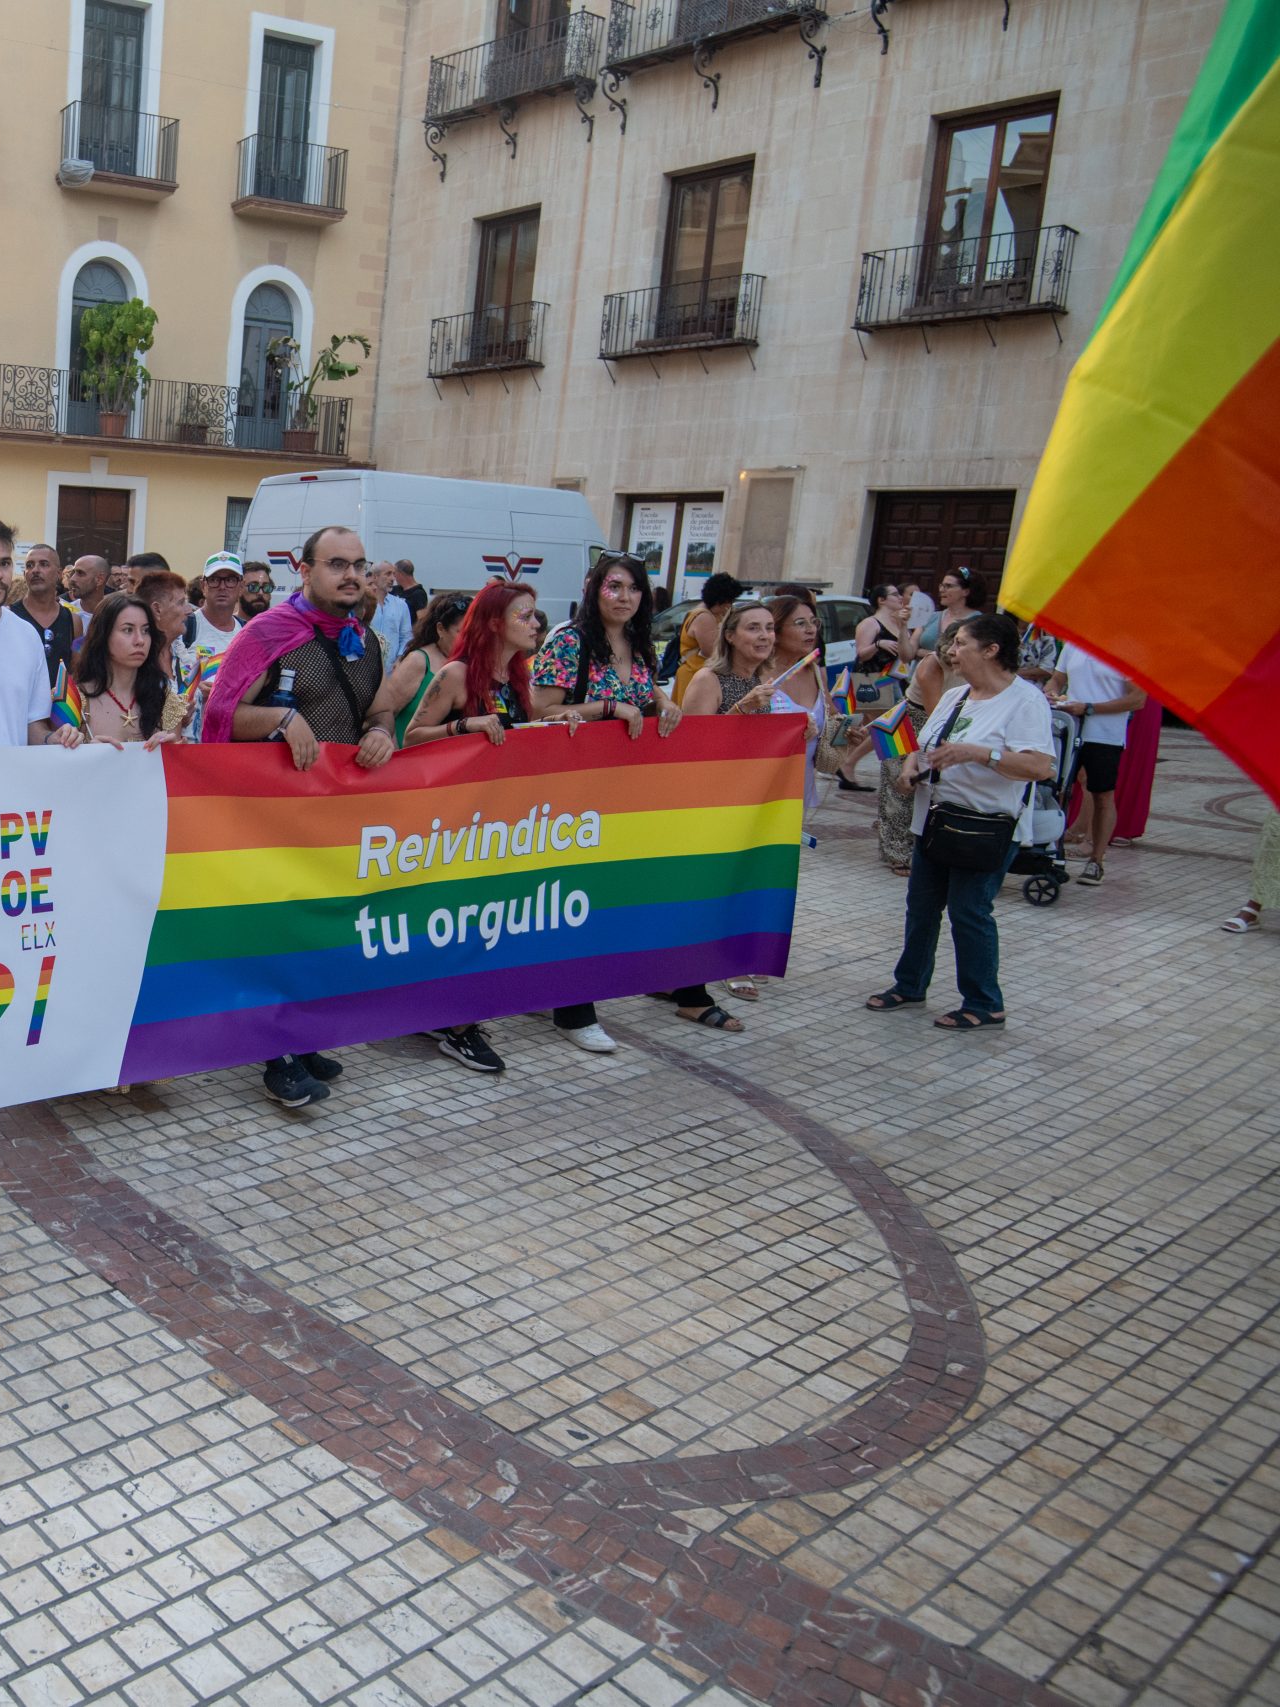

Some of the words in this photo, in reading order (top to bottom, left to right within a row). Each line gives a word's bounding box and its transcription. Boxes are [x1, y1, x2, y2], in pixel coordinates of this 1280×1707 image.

[357, 803, 600, 879] Reivindica
[21, 921, 56, 951] ELX
[355, 904, 410, 959] tu
[427, 879, 589, 951] orgullo
